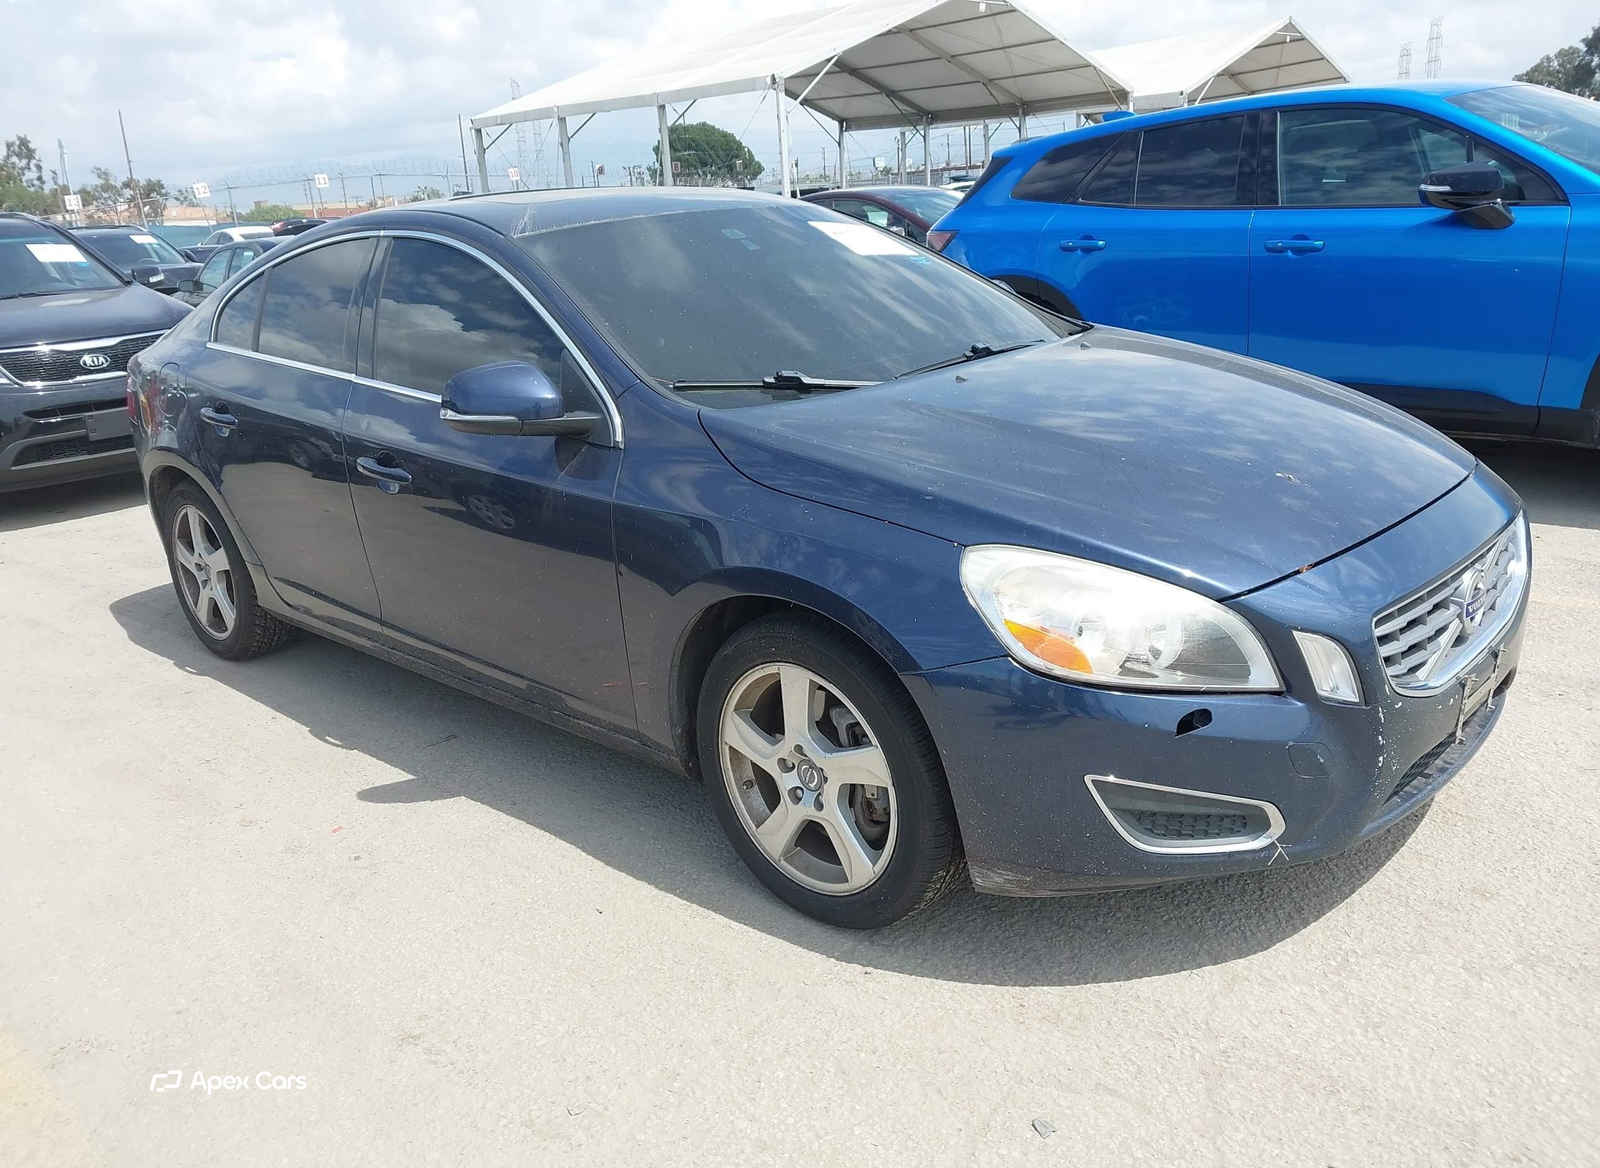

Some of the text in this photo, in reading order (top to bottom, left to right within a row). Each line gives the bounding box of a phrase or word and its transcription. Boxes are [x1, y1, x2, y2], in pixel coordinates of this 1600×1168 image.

[510, 170, 519, 178] 10
[316, 177, 328, 186] 11
[196, 186, 208, 195] 12
[67, 198, 79, 207] 13
[84, 356, 106, 367] KIA
